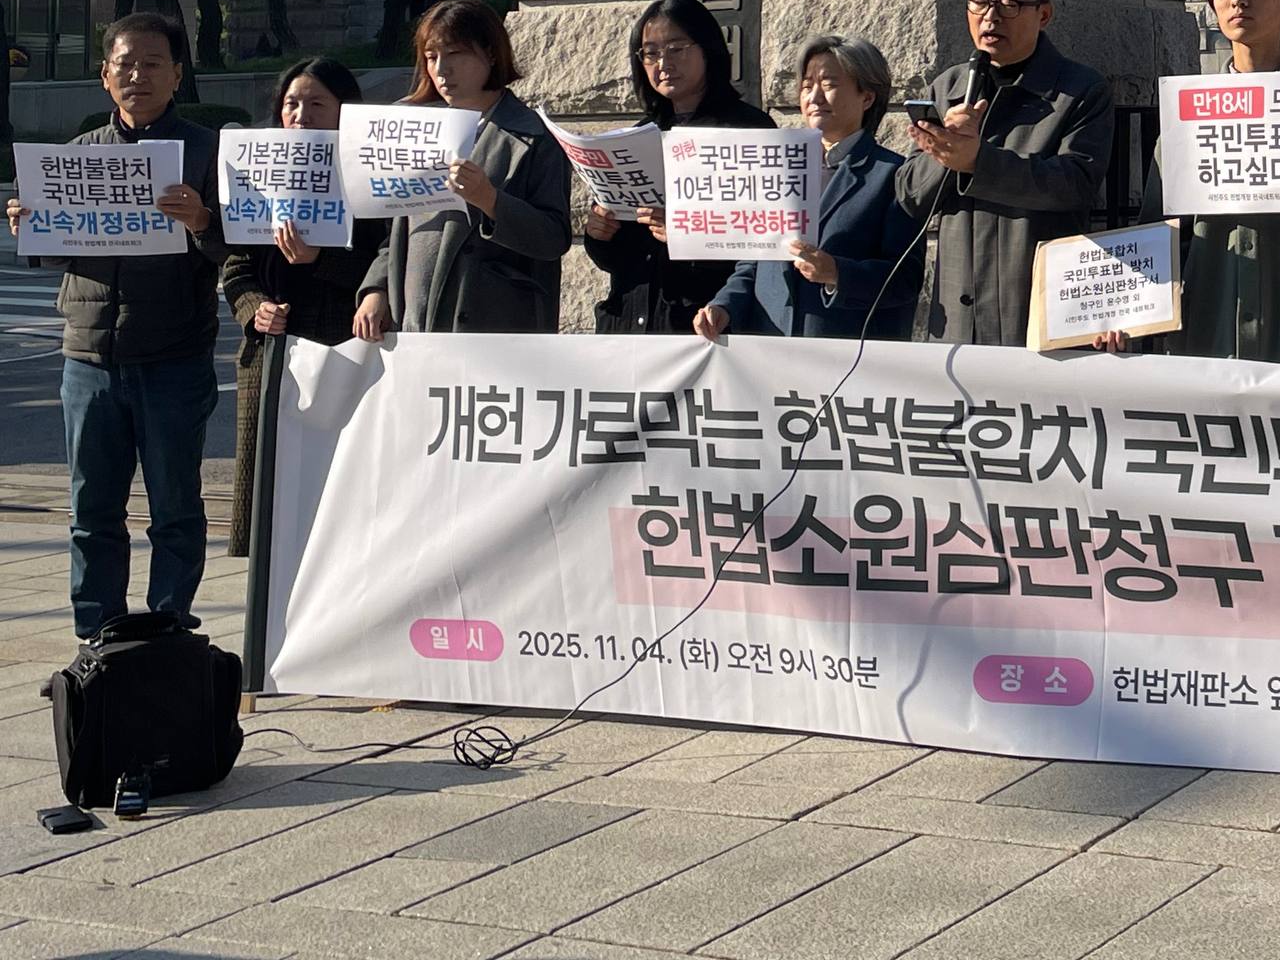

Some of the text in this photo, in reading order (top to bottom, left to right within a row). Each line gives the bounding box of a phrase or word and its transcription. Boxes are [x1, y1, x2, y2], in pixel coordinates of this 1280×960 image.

[1193, 90, 1253, 116] 만18세
[368, 119, 442, 145] 재외국민
[237, 142, 334, 166] 기본권침해
[359, 147, 449, 171] 국민투표권
[672, 139, 808, 171] 위헌 국민투표법
[40, 156, 152, 180] 헌법불합치
[236, 169, 331, 193] 국민투표법
[43, 183, 154, 206] 국민투표법
[589, 184, 664, 207] 고싶다
[674, 174, 807, 201] 10년 넘게 방치
[29, 210, 175, 235] 신속개정하라
[225, 198, 346, 224] 신속개정하라
[672, 209, 810, 235] 국회는 각성하라
[1079, 242, 1138, 264] 헌법불합치
[1063, 257, 1154, 283] 국민투표법 방치
[1059, 273, 1159, 301] 헌법소원심판청구서
[427, 385, 523, 464] 개헌
[533, 385, 763, 469] 가로막는
[773, 389, 1108, 489] 헌법불합치
[632, 486, 1265, 609] 헌법소원심판청구
[518, 631, 589, 659] 2025.
[594, 636, 625, 661] 11.
[680, 636, 719, 672] (화)
[728, 643, 774, 674] 오전
[779, 653, 817, 681] 9시
[823, 656, 880, 690] 30분
[1112, 666, 1259, 708] 헌법재판소
